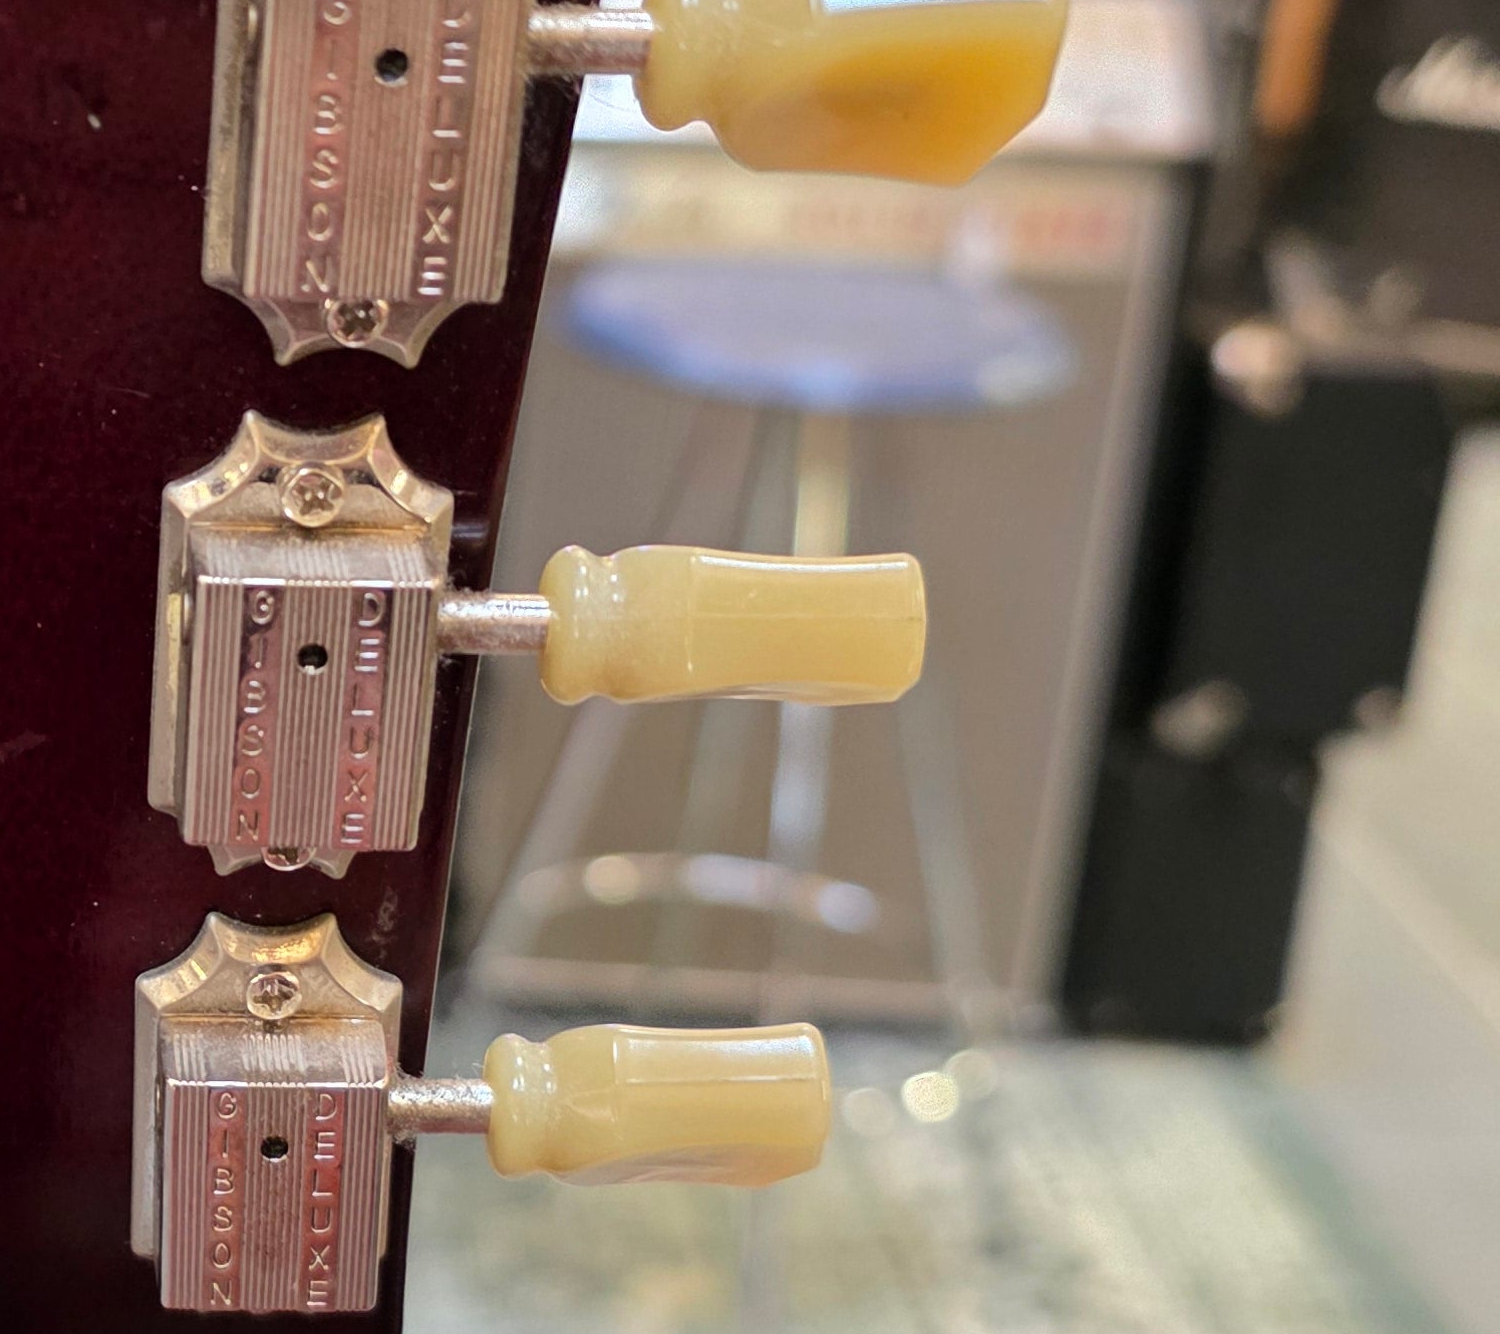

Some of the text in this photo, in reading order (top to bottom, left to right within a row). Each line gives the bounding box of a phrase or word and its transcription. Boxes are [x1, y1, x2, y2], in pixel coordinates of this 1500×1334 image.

[235, 590, 275, 841] GIBSON
[340, 592, 385, 844] DELUXE
[209, 1092, 237, 1306] GIBSON
[306, 1093, 338, 1307] DELUXE
